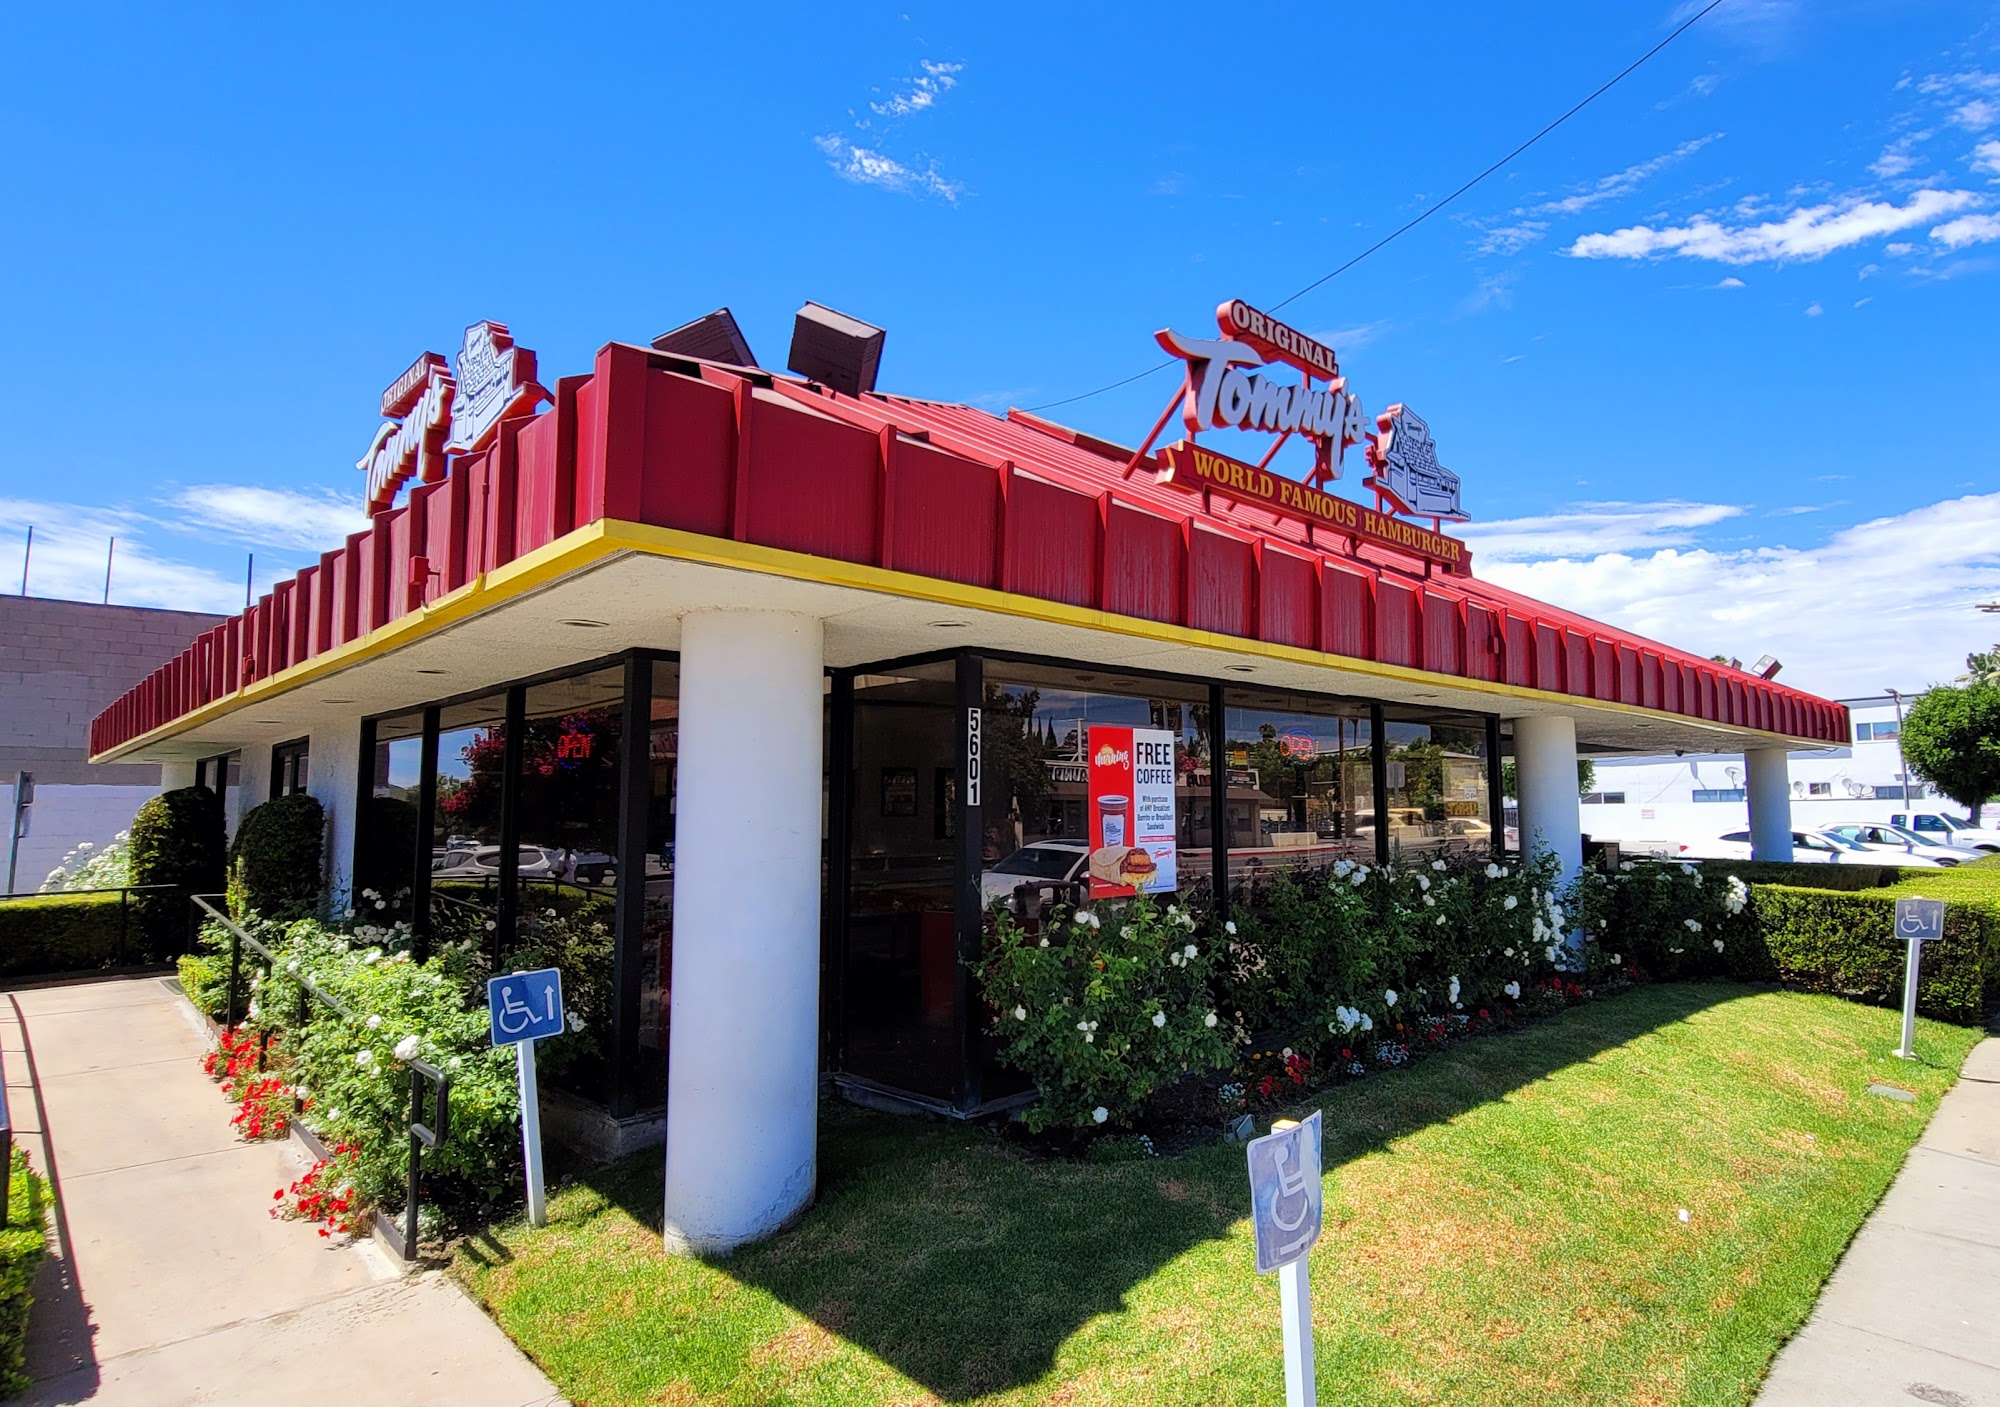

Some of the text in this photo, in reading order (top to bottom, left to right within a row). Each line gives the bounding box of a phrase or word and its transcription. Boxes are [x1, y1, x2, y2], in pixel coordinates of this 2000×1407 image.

[1232, 301, 1338, 375] ORIGINAL
[381, 355, 427, 410] ORIGINAL
[1165, 328, 1371, 480] Tommy's
[1192, 450, 1461, 562] WORLD FAMOUS HAMBURGER
[557, 733, 591, 758] OPEN
[969, 709, 979, 804] 5601
[1136, 742, 1171, 766] FREE
[1136, 768, 1172, 784] COFFEE
